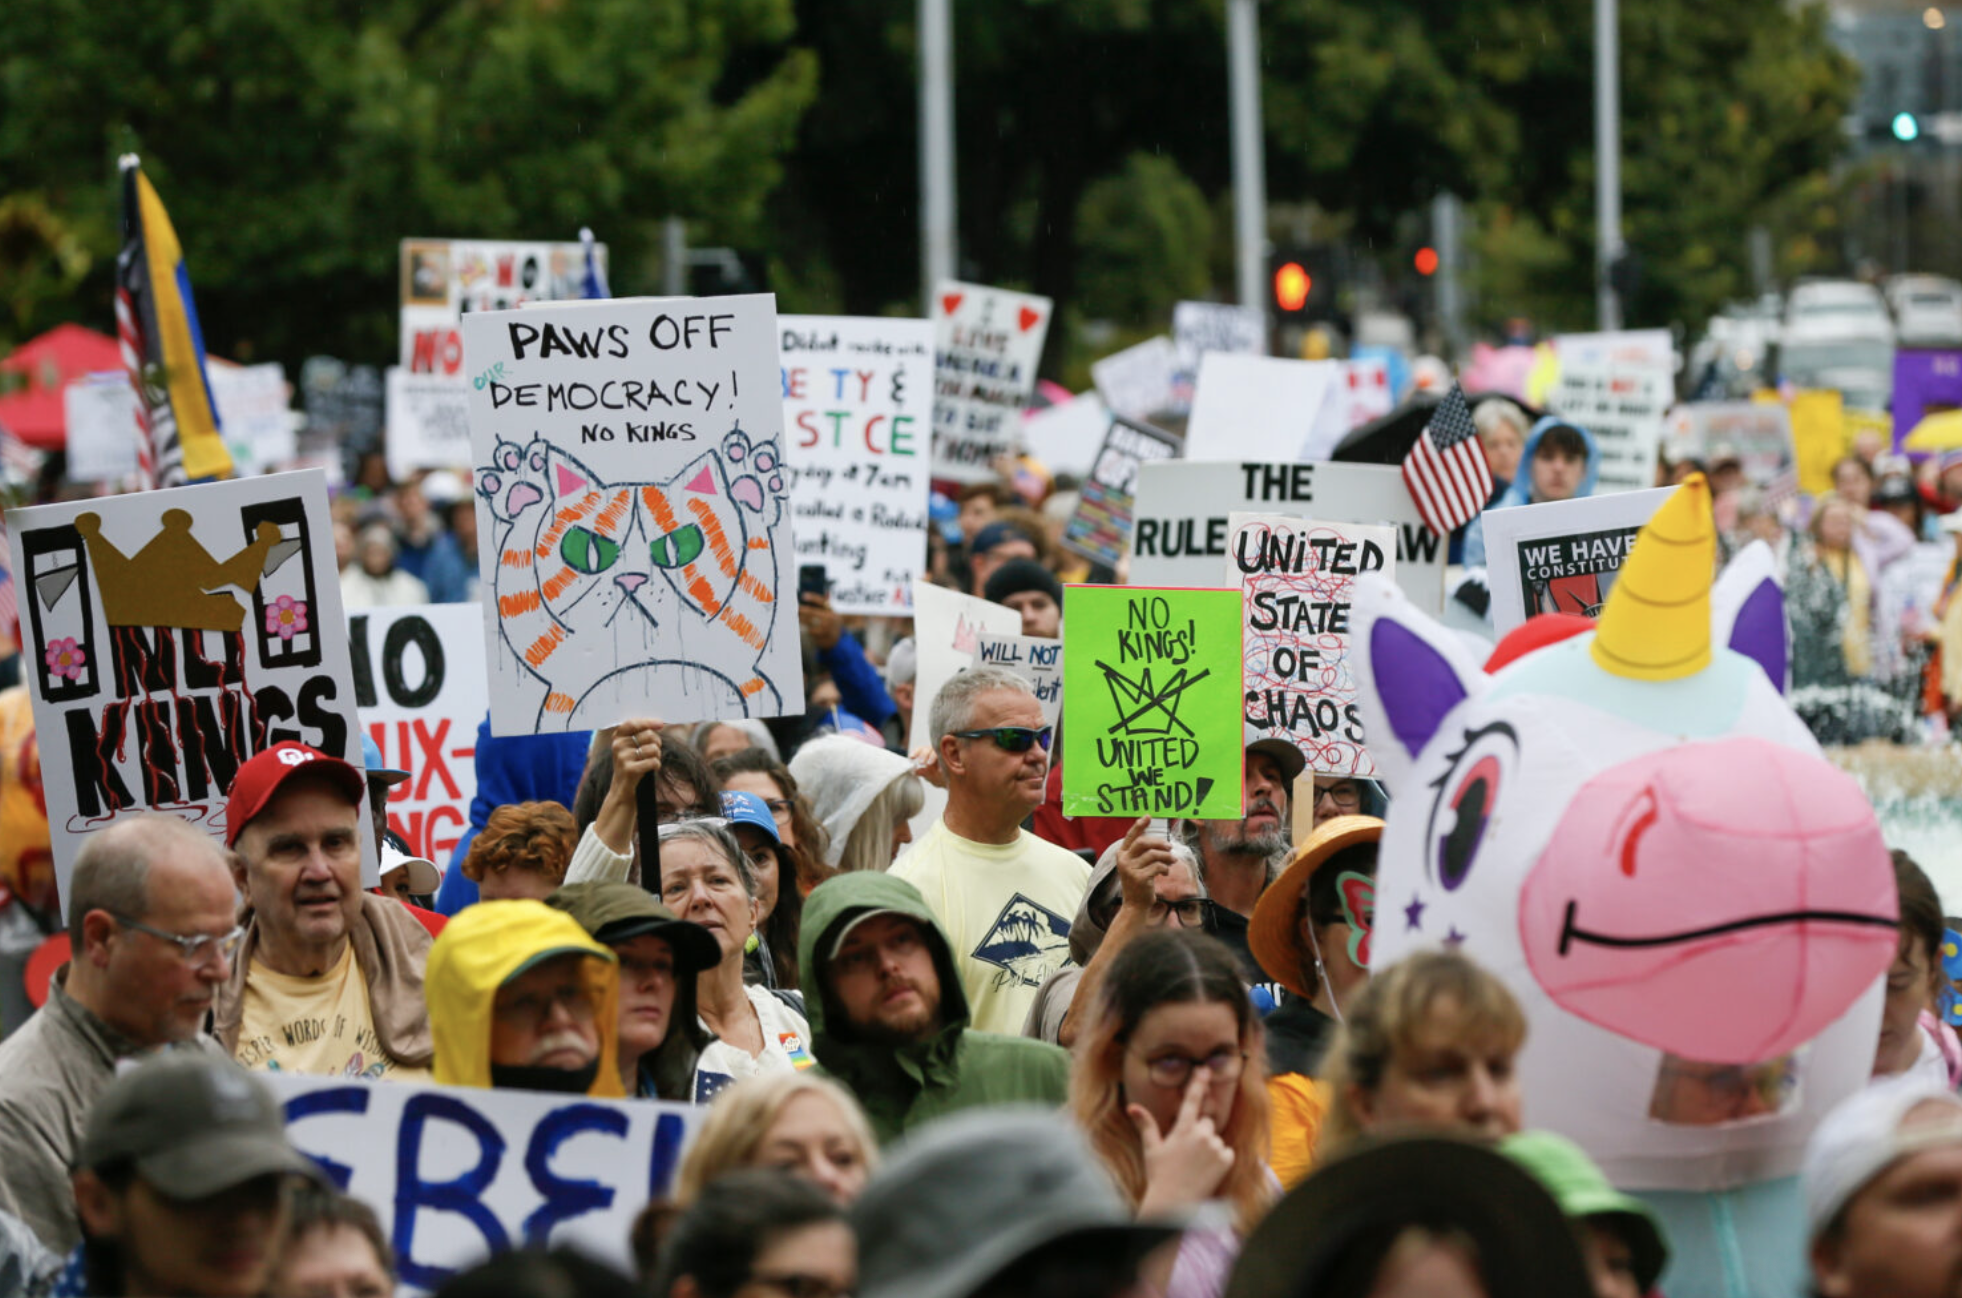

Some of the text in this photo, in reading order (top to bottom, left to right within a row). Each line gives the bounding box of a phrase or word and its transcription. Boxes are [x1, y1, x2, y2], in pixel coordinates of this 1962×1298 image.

[508, 314, 735, 360] PAWS OFF
[489, 370, 739, 412] DEMOCRACY!
[581, 421, 697, 444] NO KINGS
[1241, 463, 1315, 501] THE
[1134, 518, 1229, 557] RULE
[1524, 534, 1637, 566] WE HAVE
[1128, 597, 1170, 631] NO
[980, 641, 1062, 665] WILL NOT
[1117, 619, 1196, 665] KINGS!
[1272, 646, 1321, 683] OF
[1244, 689, 1365, 746] CHAOS
[64, 675, 348, 818] KINGS
[1096, 737, 1200, 770] UNITED
[1127, 766, 1164, 787] WE
[1096, 777, 1215, 816] STAND!
